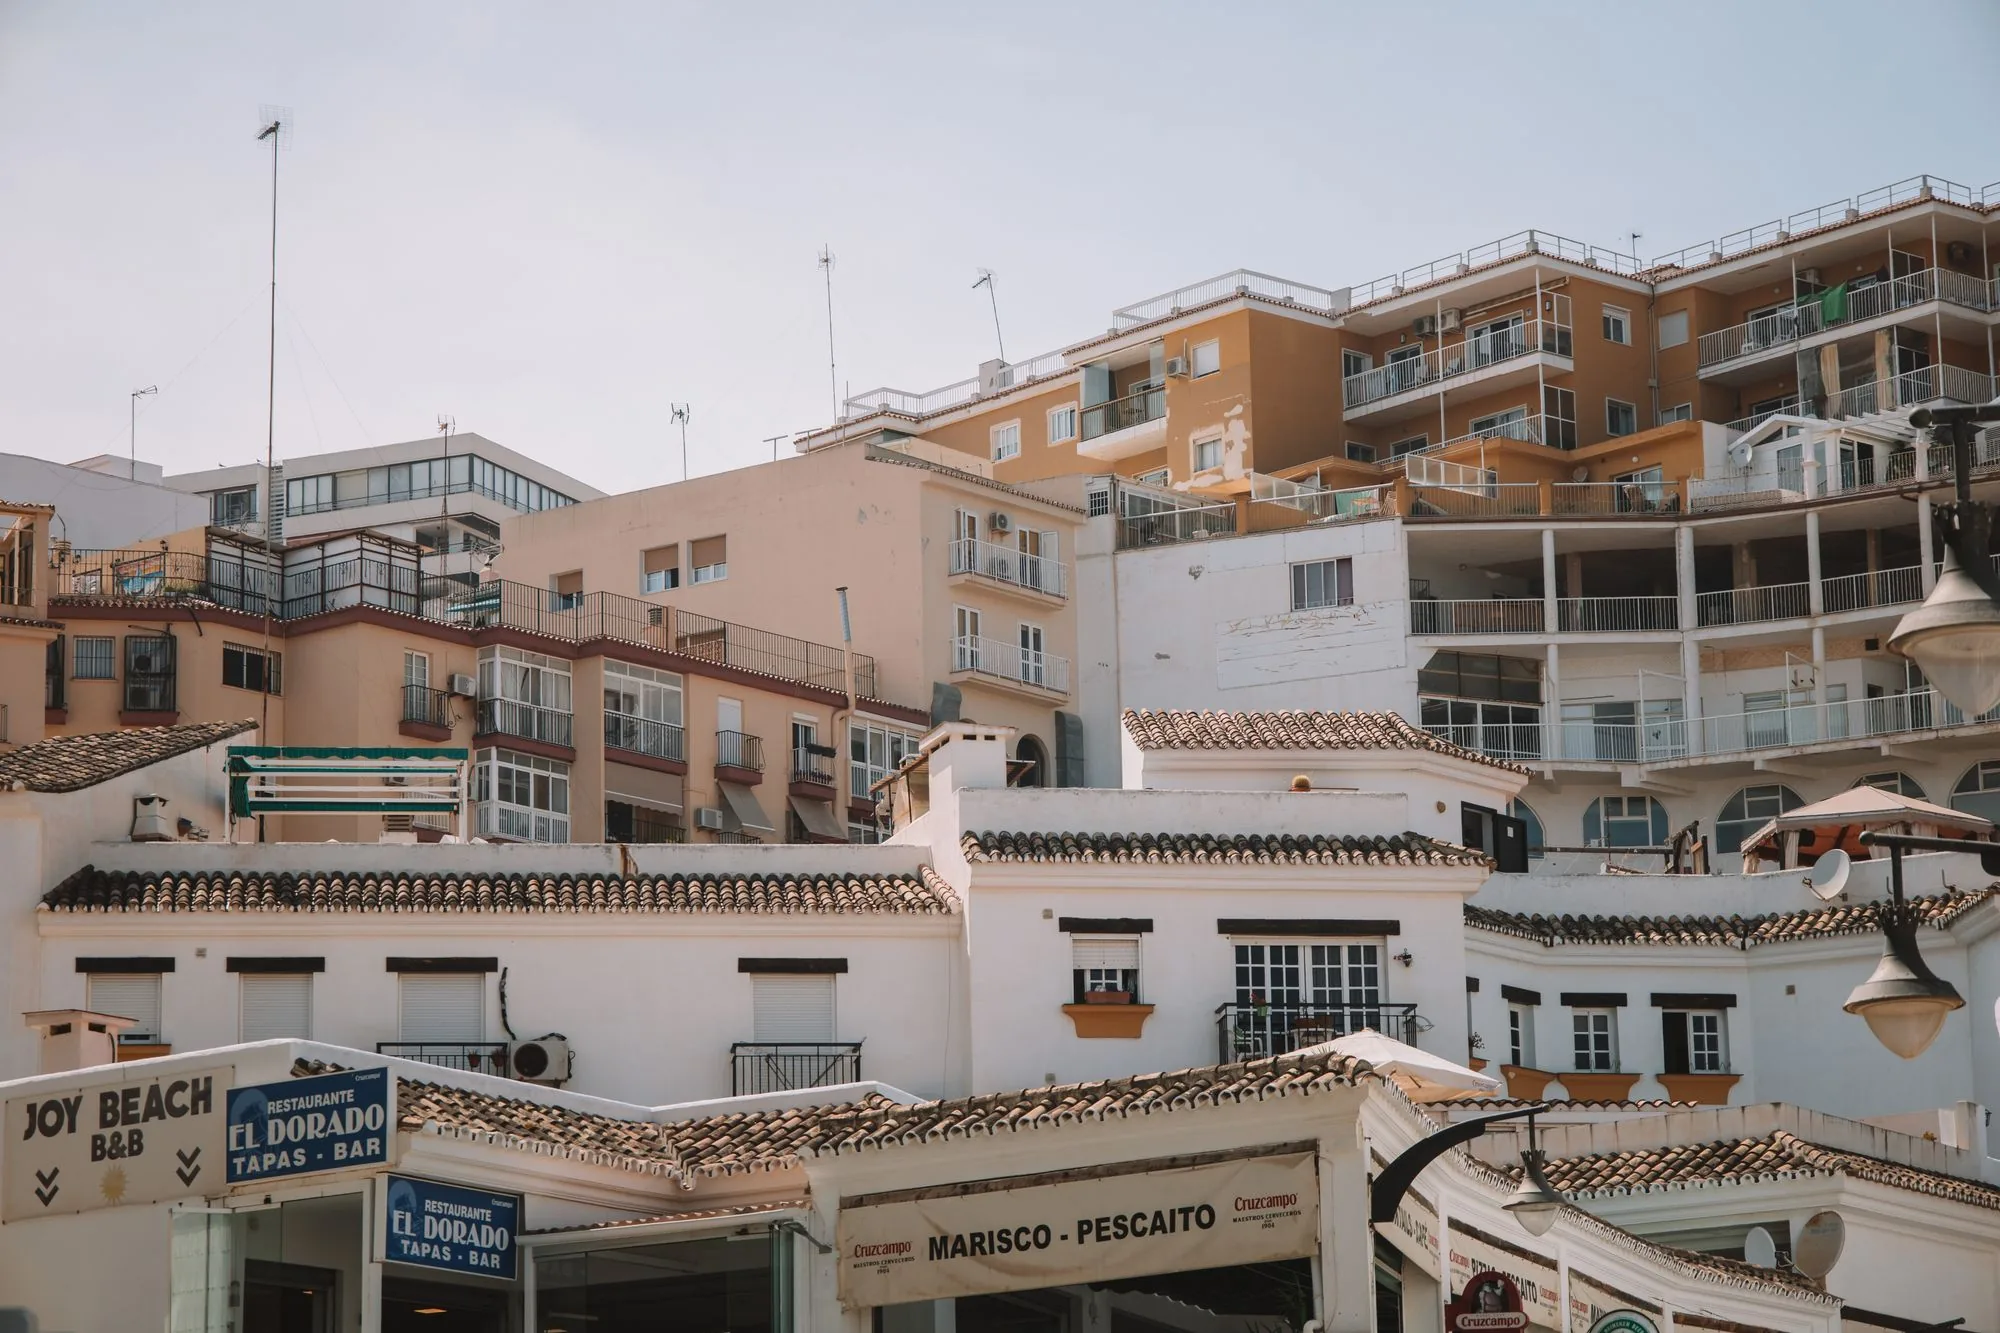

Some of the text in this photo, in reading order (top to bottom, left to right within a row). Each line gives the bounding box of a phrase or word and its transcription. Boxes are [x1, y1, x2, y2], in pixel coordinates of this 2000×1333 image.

[23, 1076, 212, 1141] JOY BEACH
[267, 1089, 355, 1115] RESTAURANTE
[229, 1103, 385, 1151] EL DORADO
[91, 1128, 144, 1162] B&B
[233, 1148, 306, 1175] TAPAS
[334, 1137, 381, 1161] BAR
[424, 1199, 492, 1222] RESTAURANTE
[1234, 1193, 1298, 1211] Cruzcampo
[392, 1209, 510, 1251] EL DORADO
[928, 1224, 1051, 1261] MARISCO
[1077, 1204, 1216, 1245] PESCAITO
[401, 1239, 451, 1261] TAPAS
[469, 1250, 500, 1269] BAR
[854, 1241, 912, 1258] Cruzcampo
[1461, 1315, 1520, 1328] Cruzcampo
